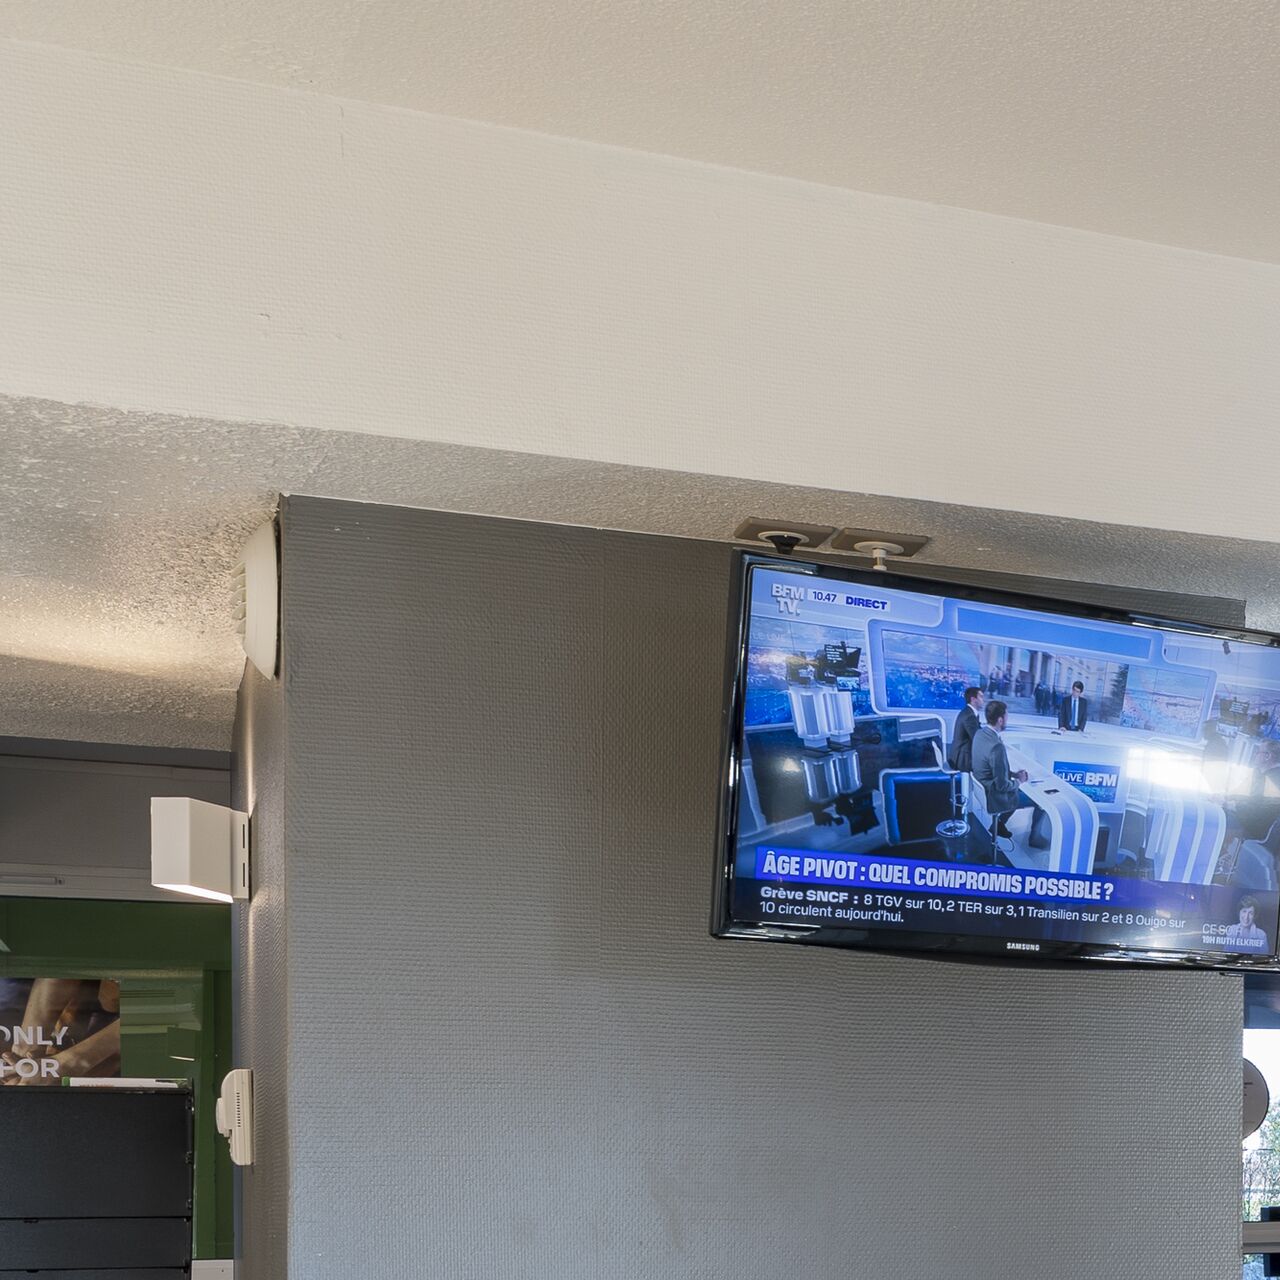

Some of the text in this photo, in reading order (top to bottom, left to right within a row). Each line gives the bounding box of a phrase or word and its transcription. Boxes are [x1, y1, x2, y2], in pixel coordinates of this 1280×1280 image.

[771, 583, 888, 610] BFM 10.47 DIRECT
[1085, 772, 1117, 787] BFM
[762, 851, 1114, 901] ÂGE PIVOT : QUEL COMPROMIS POSSIBLE ?
[759, 901, 904, 923] 10 circulent aujourd'hui.
[760, 886, 803, 900] Grève
[806, 889, 849, 904] SNCF
[864, 894, 873, 905] 8
[875, 895, 902, 907] TGV
[905, 898, 924, 909] sur
[958, 901, 982, 914] TER
[984, 904, 1003, 915] sur
[1026, 906, 1079, 921] Transilien
[1081, 911, 1100, 922] sur
[1101, 912, 1110, 923] 2
[1111, 912, 1123, 924] et
[1126, 913, 1133, 924] 8
[1135, 916, 1167, 929] Ouigo
[1169, 918, 1186, 928] sur
[1202, 923, 1217, 934] CE
[1006, 942, 1040, 951] SAMSUNG
[1216, 936, 1235, 945] RUTH
[1235, 937, 1264, 947] ELKRIEF
